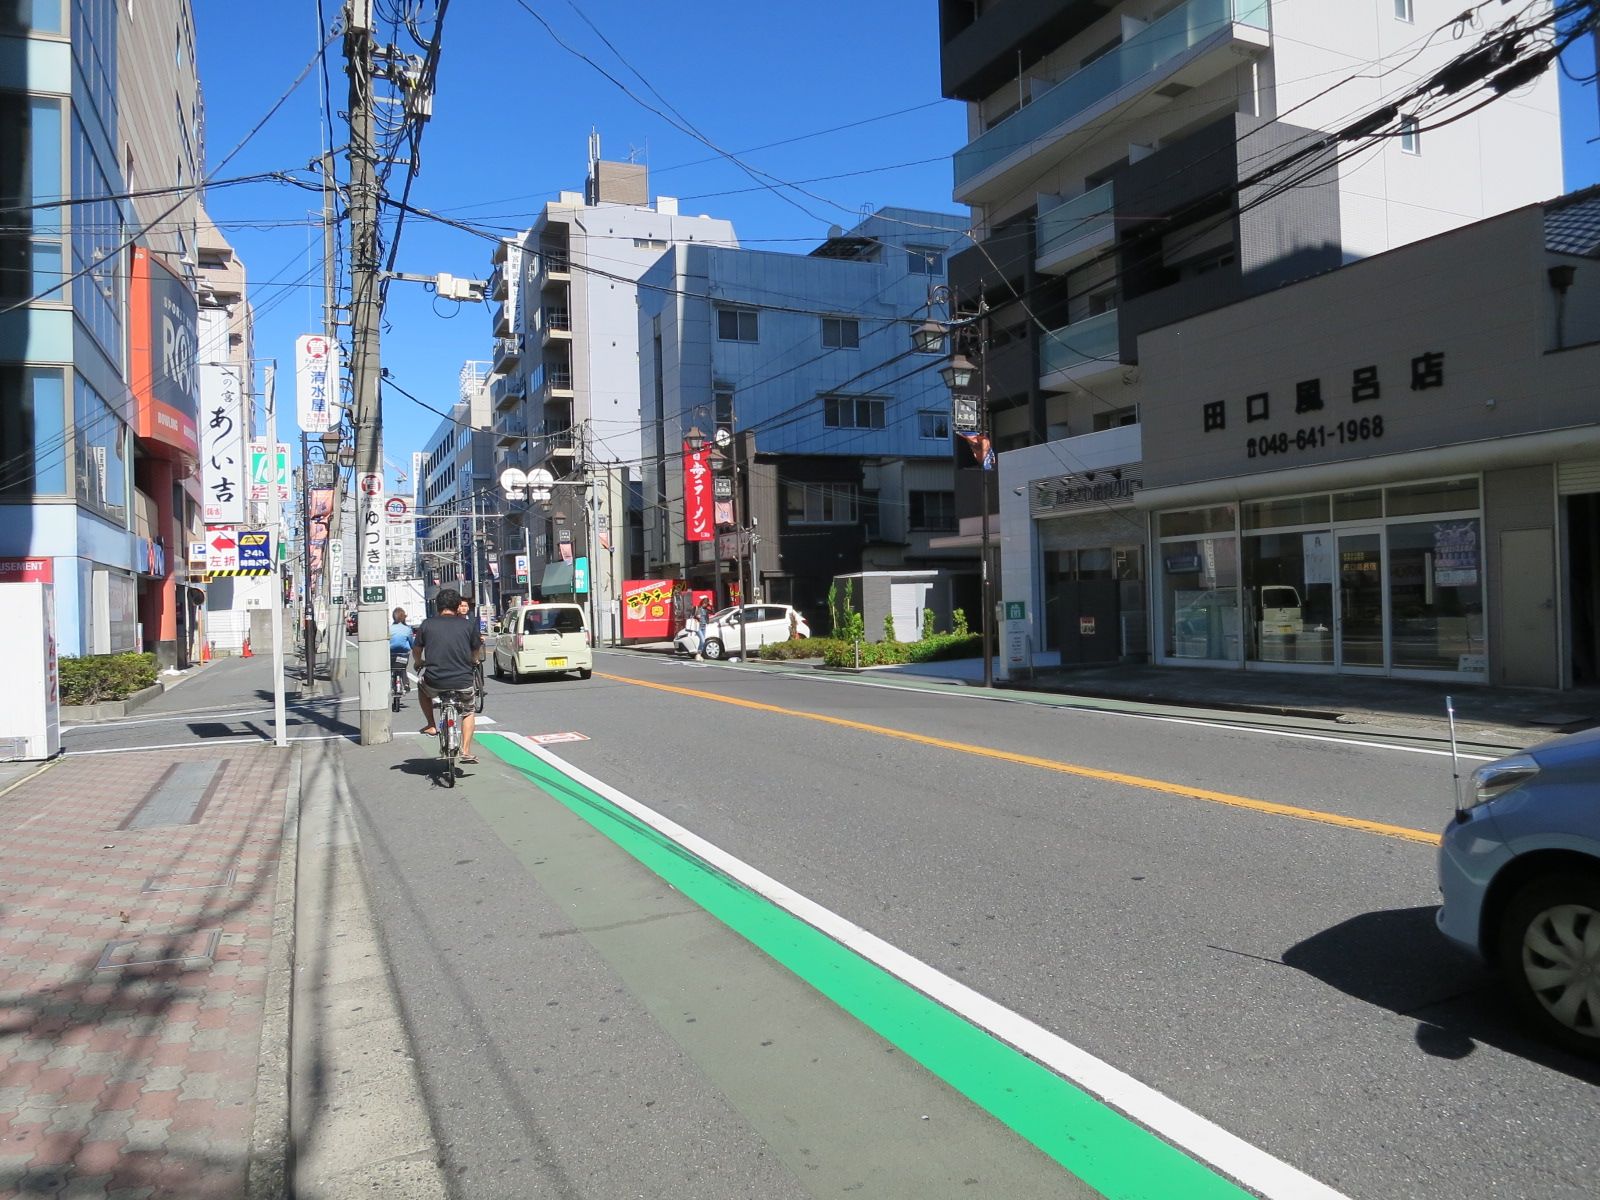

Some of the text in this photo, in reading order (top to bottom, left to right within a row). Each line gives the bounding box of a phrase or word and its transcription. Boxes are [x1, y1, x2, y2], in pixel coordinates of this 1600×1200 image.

[221, 372, 236, 402] 一の宮
[311, 371, 326, 411] 清水屋
[1203, 351, 1445, 433] 田口風呂店
[210, 406, 236, 503] あい吉
[1259, 415, 1384, 456] 048-641-1968
[390, 503, 403, 513] 30
[365, 510, 380, 563] ゆづき
[209, 556, 236, 567] 左折
